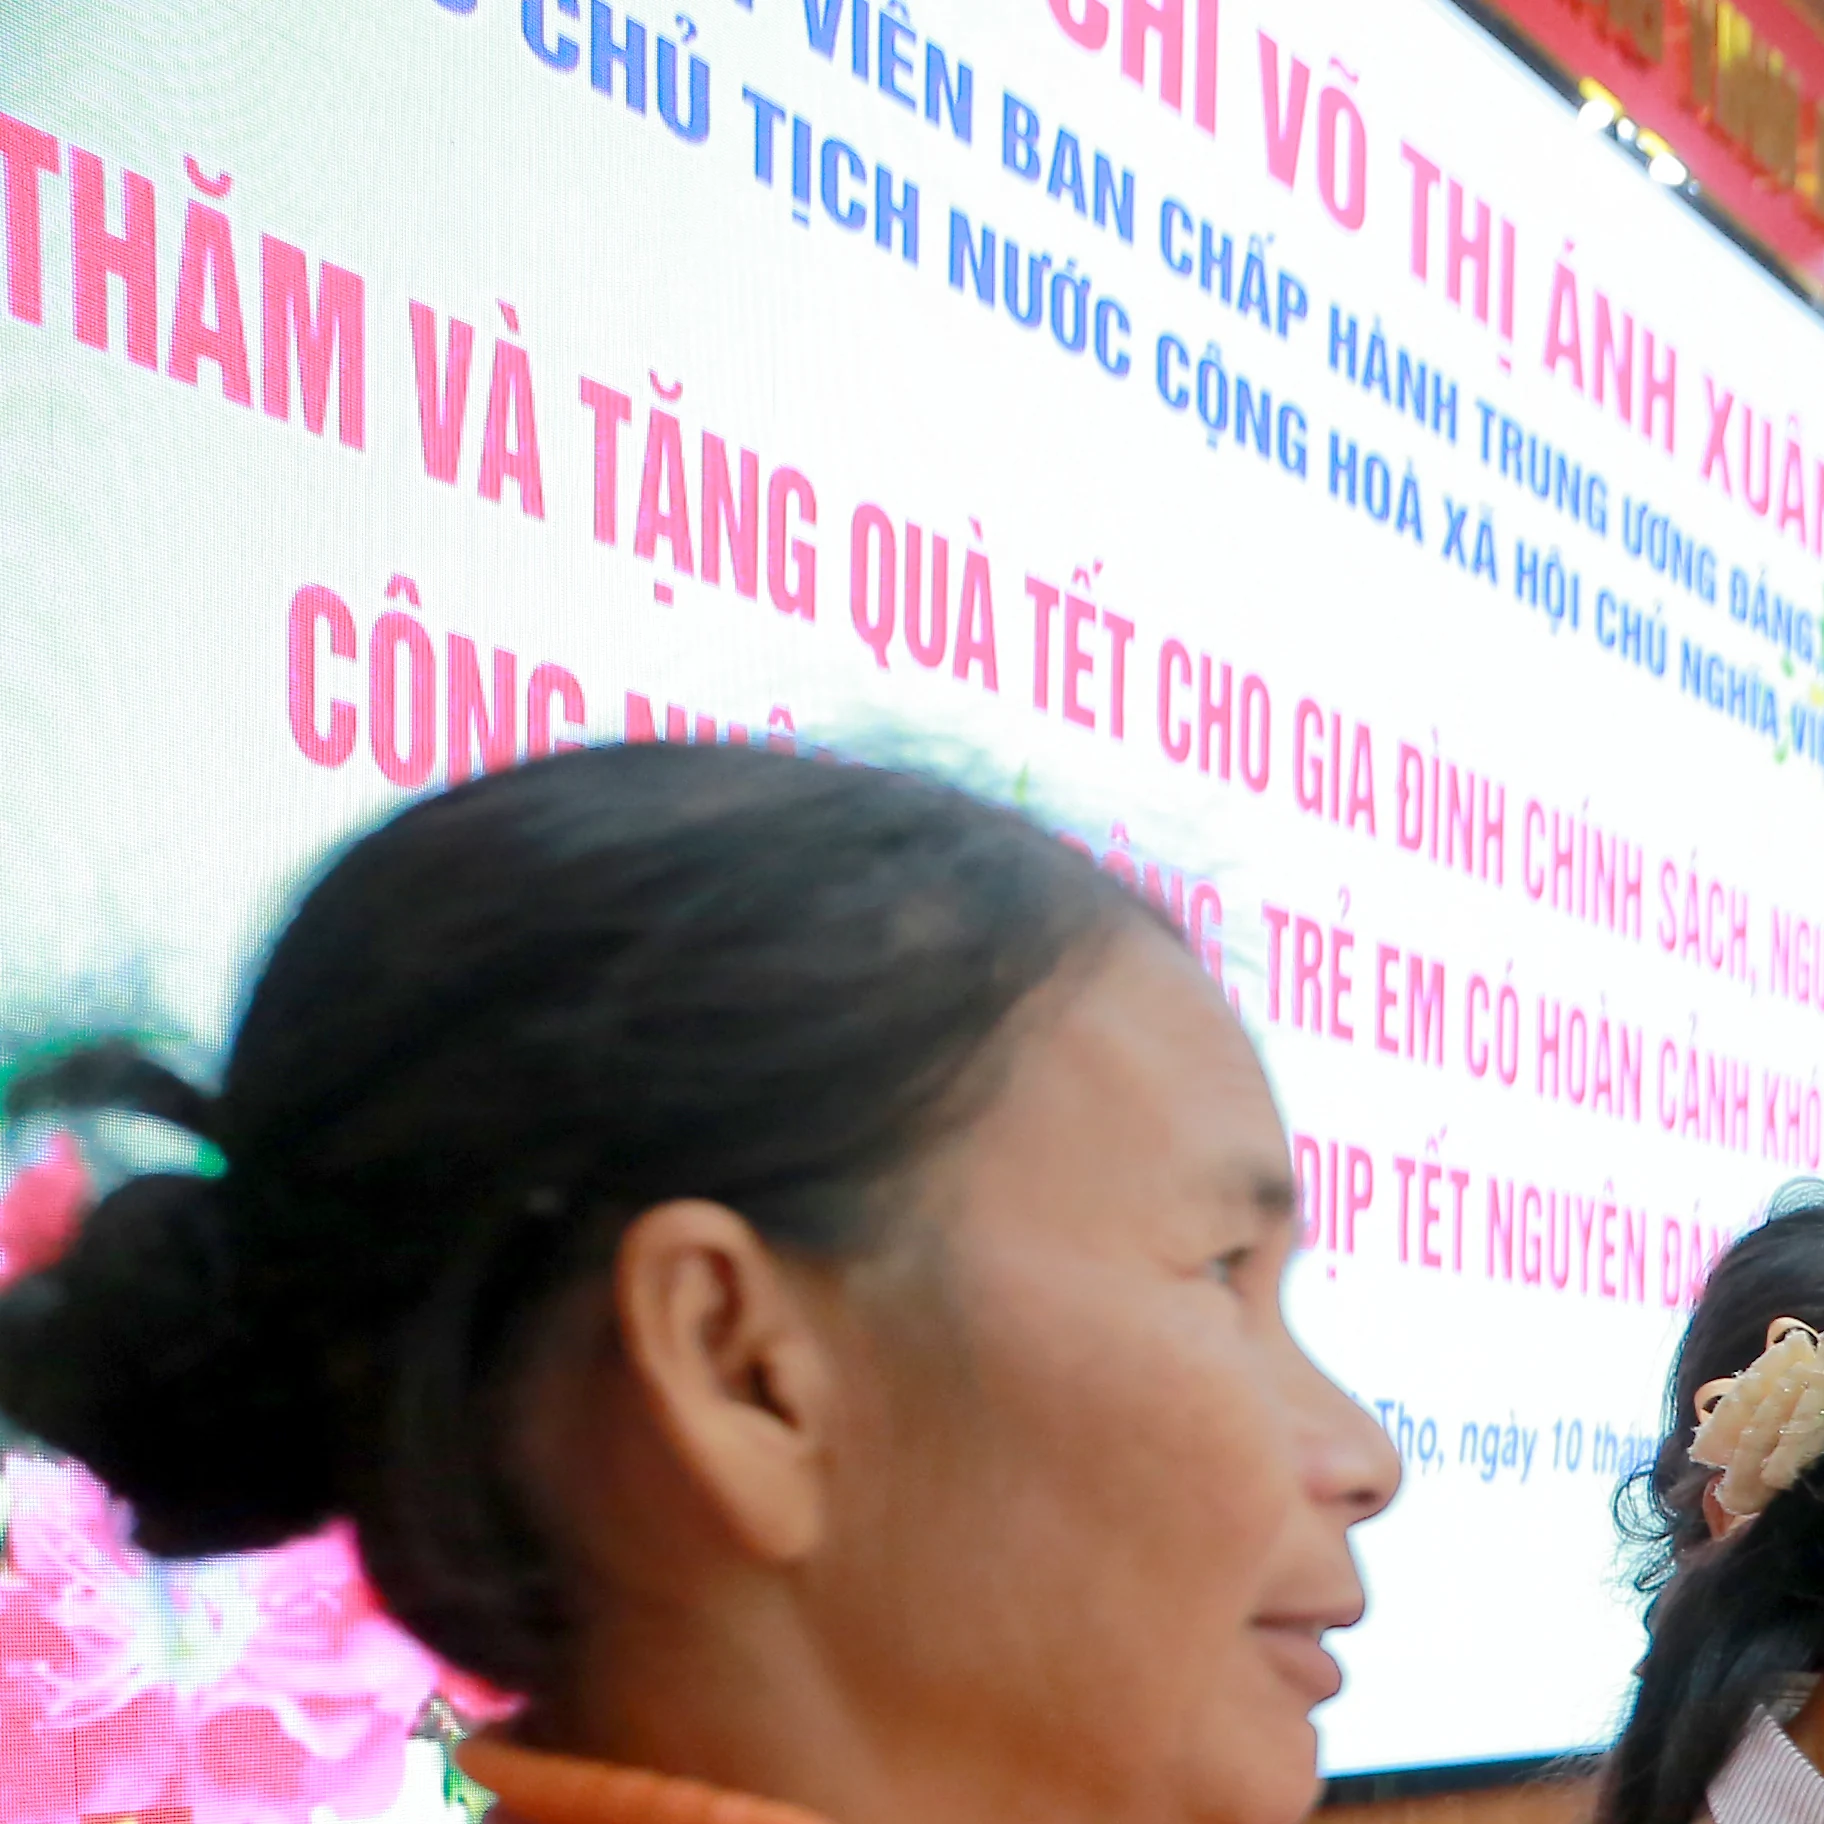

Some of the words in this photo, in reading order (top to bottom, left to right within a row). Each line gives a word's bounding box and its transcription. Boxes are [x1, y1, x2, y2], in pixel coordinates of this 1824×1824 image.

[519, 0, 711, 146] CHỦ
[741, 82, 920, 267] TỊCH
[948, 204, 1131, 378] NƯỚC
[1155, 332, 1308, 482] CỘNG
[1328, 429, 1424, 547] HOÀ
[1441, 492, 1499, 588] XÃ
[1515, 540, 1580, 636] HỘI
[1680, 637, 1780, 740] NGHĨA
[803, 0, 973, 147] VIÊN
[1002, 90, 1135, 246] BAN
[1160, 197, 1308, 340] CHẤP
[1328, 301, 1458, 446] HÀNH
[1475, 398, 1609, 537] TRUNG
[1622, 495, 1717, 607] ƯƠNG
[1257, 28, 1368, 233] VÕ
[1401, 140, 1517, 373] THỊ
[1543, 238, 1677, 456] ÁNH
[0, 112, 366, 452] THĂM
[409, 298, 545, 521] VÀ
[580, 370, 817, 623] TẶNG
[849, 502, 1001, 693] QUÀ
[1024, 557, 1135, 742] TẾT
[1157, 636, 1271, 795] CHO
[1294, 697, 1377, 838] GIA
[1396, 726, 1506, 888] ĐÌNH
[1524, 796, 1644, 942] CHÍNH
[1657, 848, 1758, 998] SÁCH,
[1262, 885, 1355, 1043] TRẺ
[1375, 940, 1446, 1067] EM
[1464, 960, 1519, 1087] CÓ
[1536, 991, 1643, 1123] HOÀN
[1657, 1010, 1750, 1154] CẢNH
[1763, 1065, 1822, 1171] KHÓ
[1293, 1131, 1374, 1280] DỊP
[1393, 1124, 1469, 1272] TẾT
[1485, 1179, 1645, 1306] NGUYÊN
[1660, 1199, 1736, 1310] ĐÁ
[1459, 1409, 1538, 1484] ngày
[1551, 1417, 1584, 1473] 10
